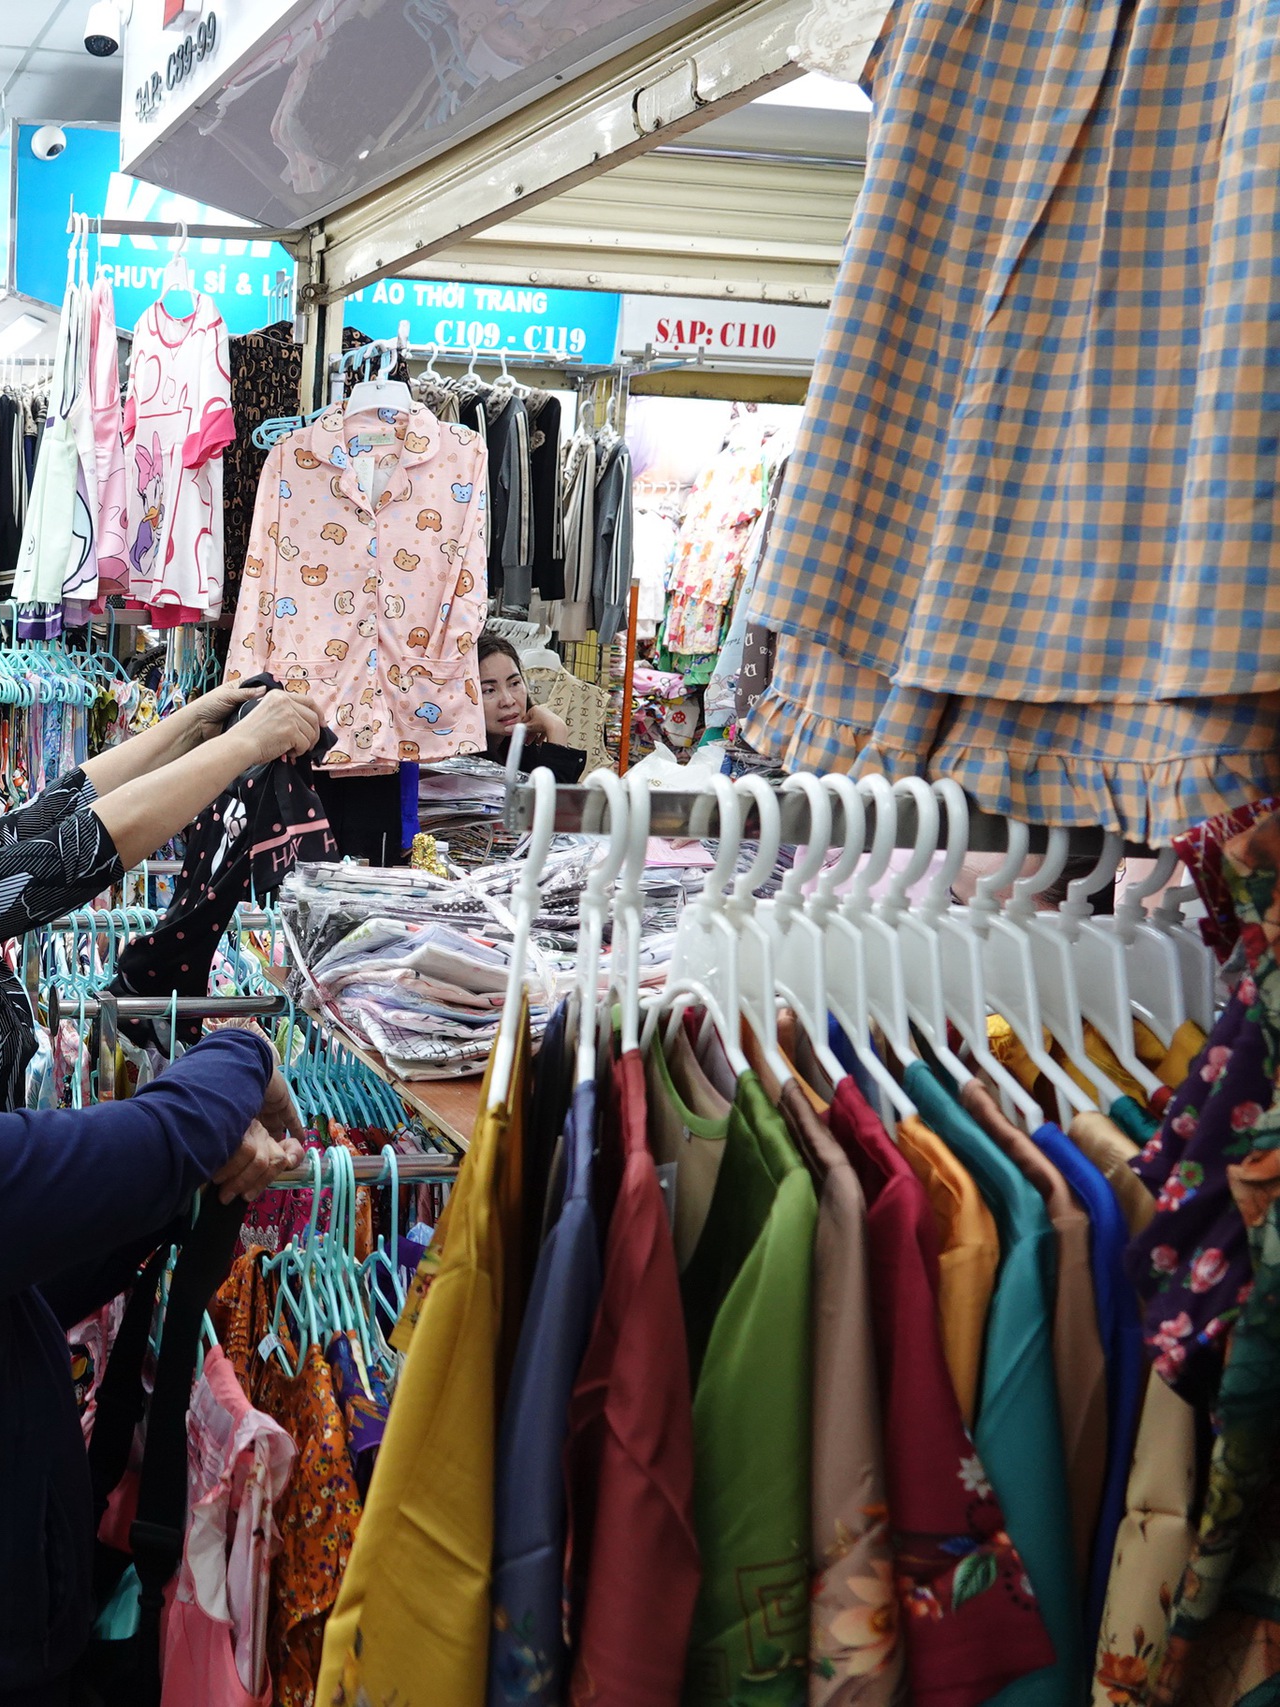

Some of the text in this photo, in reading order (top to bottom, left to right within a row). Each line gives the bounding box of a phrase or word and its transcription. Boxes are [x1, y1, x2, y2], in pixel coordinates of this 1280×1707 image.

[166, 11, 217, 91] C89-99
[236, 272, 253, 295] &
[473, 287, 548, 314] TRANG
[434, 319, 501, 348] C109
[523, 325, 587, 353] C119
[655, 317, 777, 351] SẠP: C110
